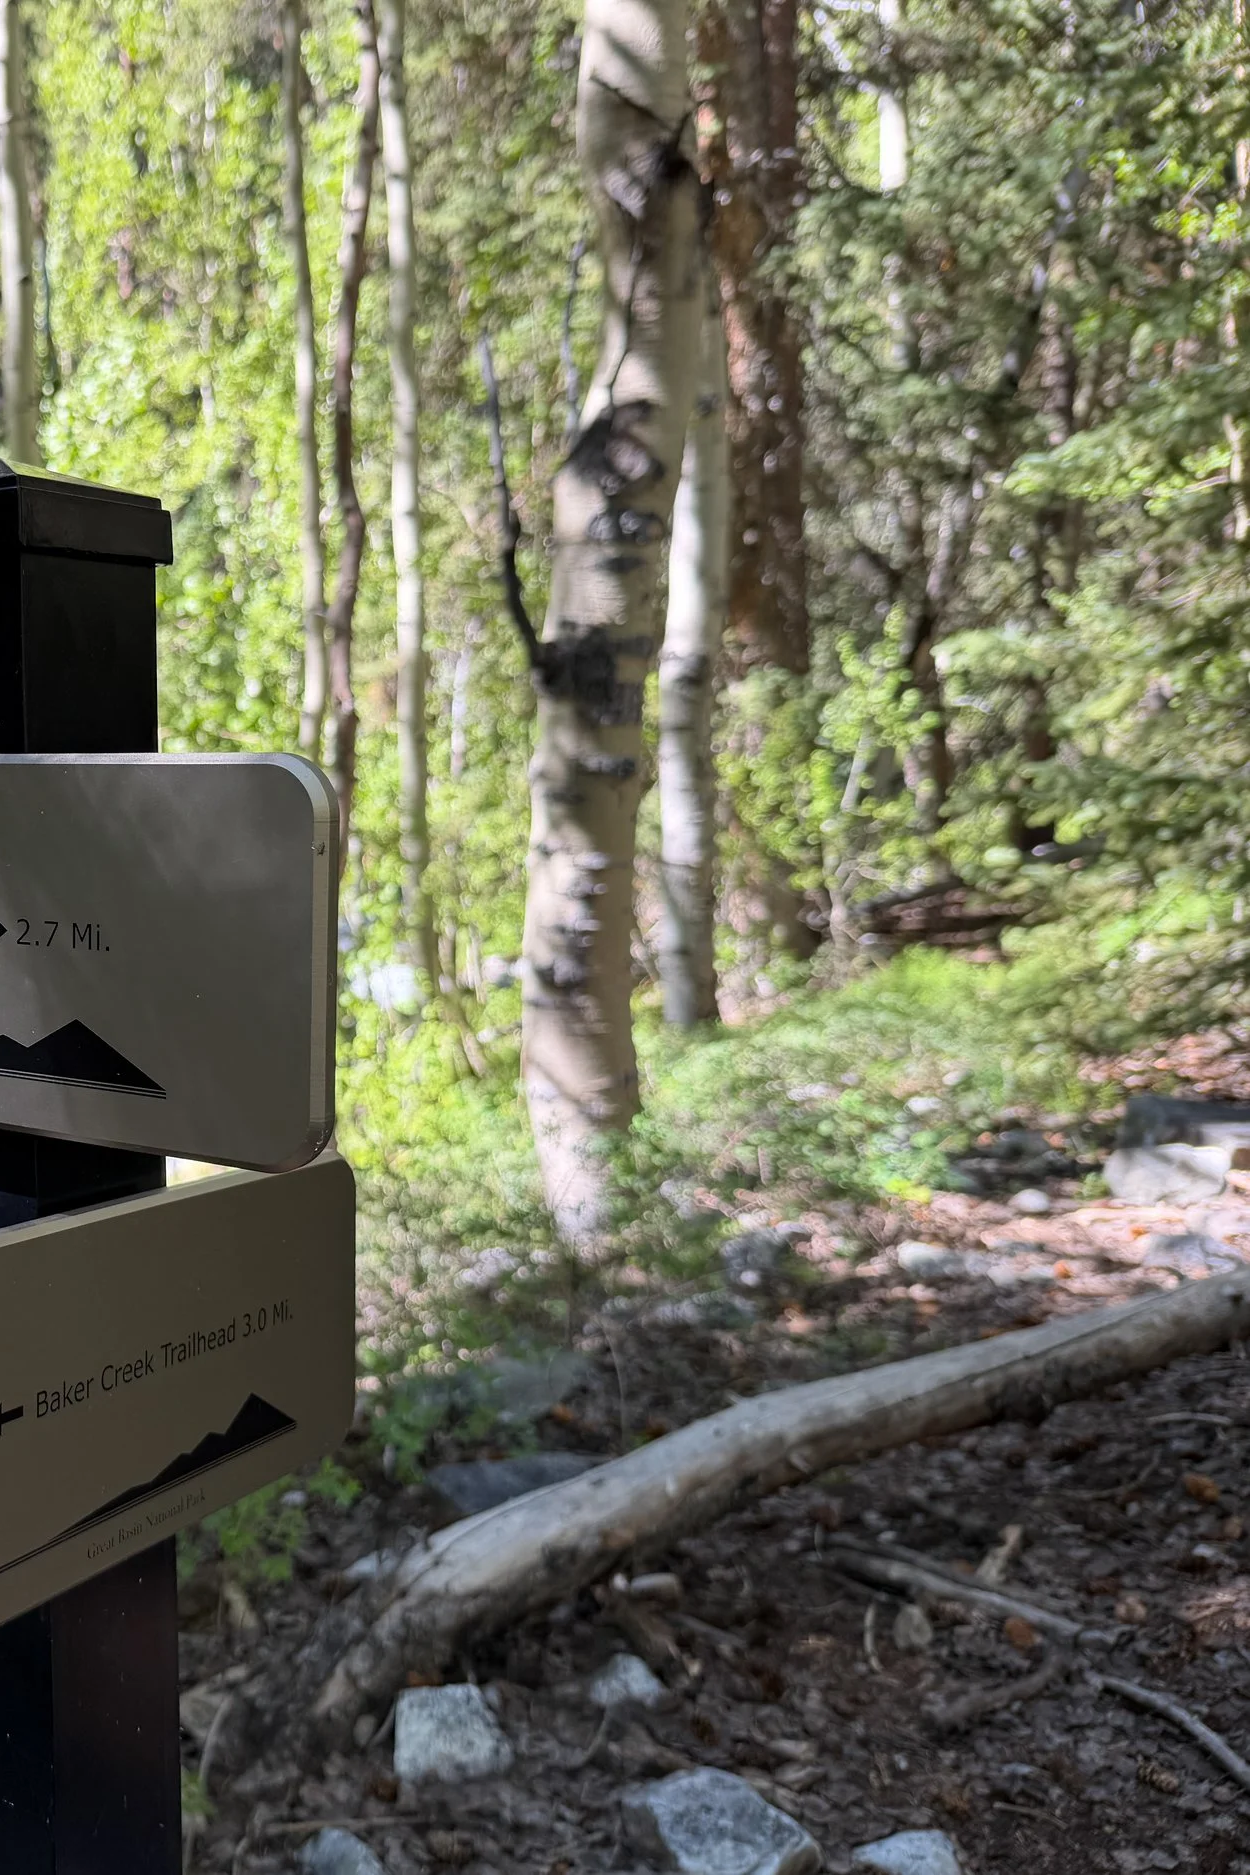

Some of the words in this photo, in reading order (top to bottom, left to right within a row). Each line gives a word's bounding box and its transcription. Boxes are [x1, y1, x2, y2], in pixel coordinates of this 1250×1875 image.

[16, 917, 59, 947] 2.7
[71, 921, 110, 952] Mi.
[36, 1376, 95, 1419] Baker
[100, 1349, 156, 1392] Creek
[160, 1317, 237, 1369] Trailhead
[242, 1307, 267, 1338] 3.0
[272, 1298, 294, 1326] Mi.
[145, 1496, 184, 1527] National
